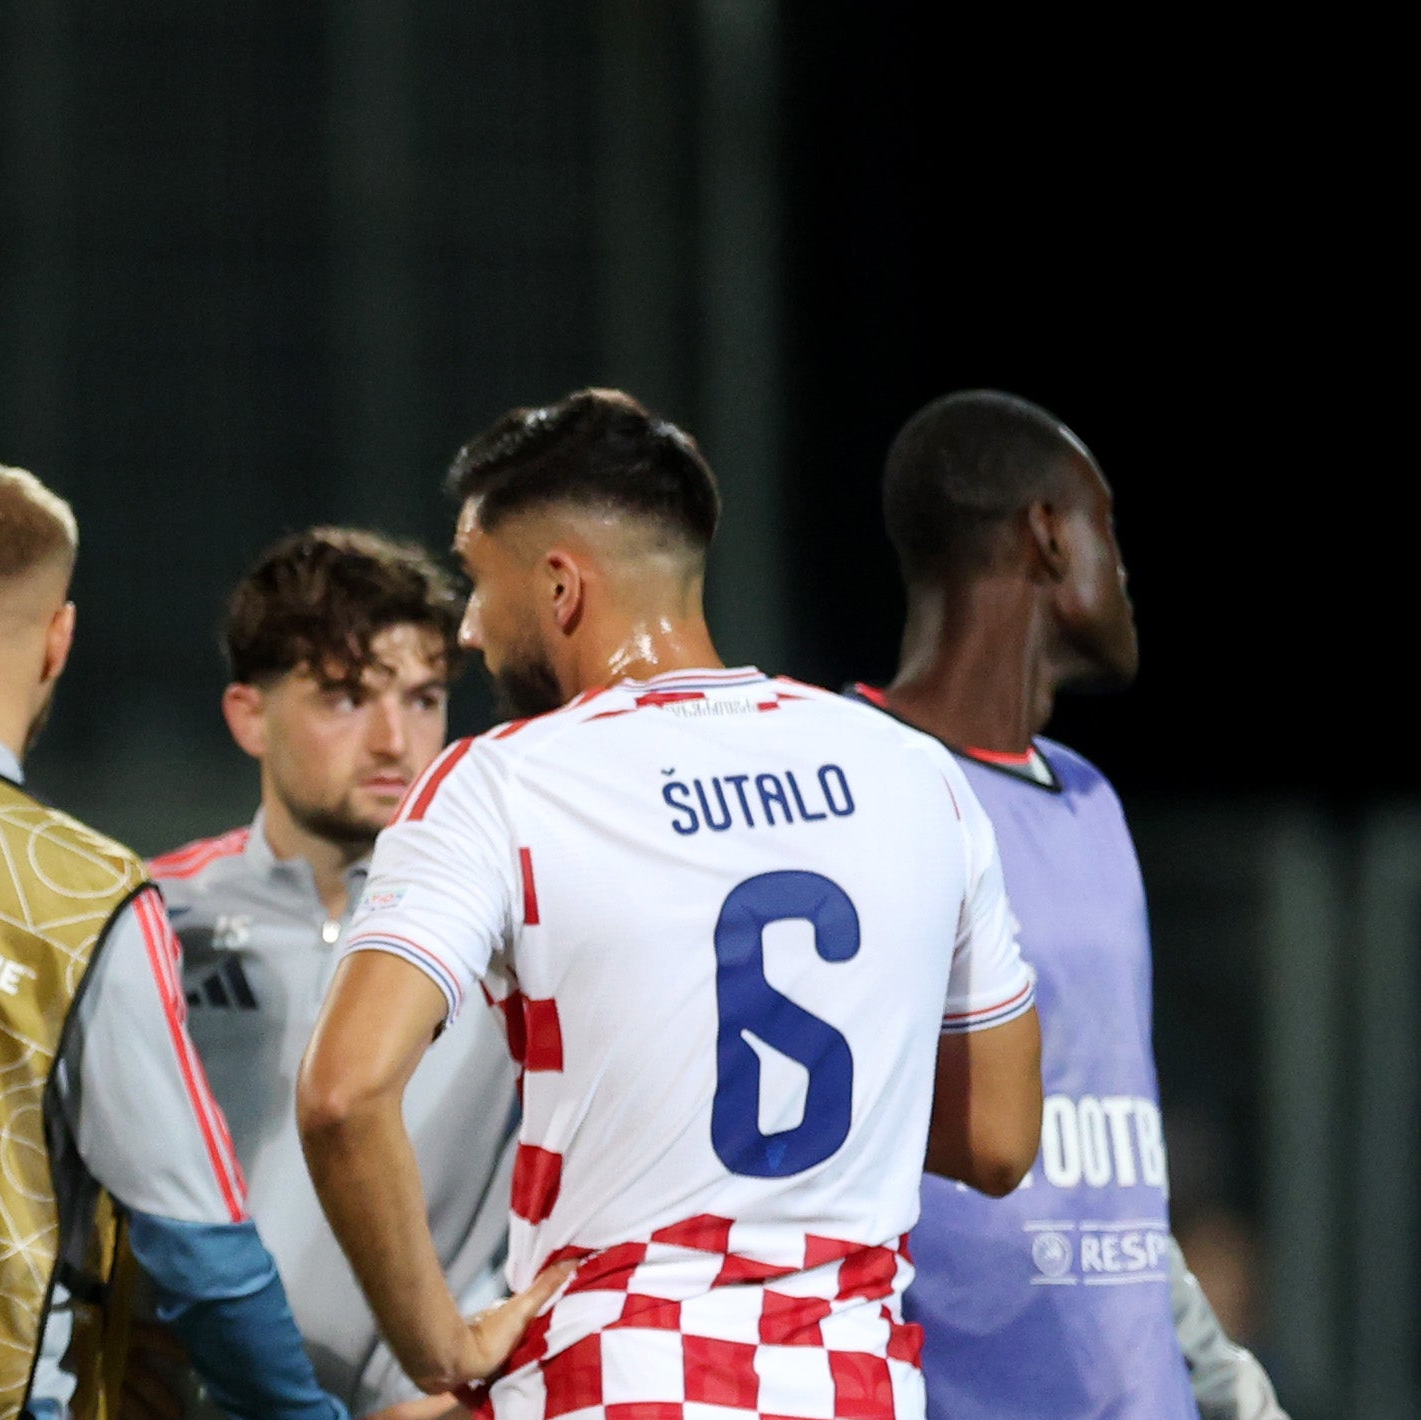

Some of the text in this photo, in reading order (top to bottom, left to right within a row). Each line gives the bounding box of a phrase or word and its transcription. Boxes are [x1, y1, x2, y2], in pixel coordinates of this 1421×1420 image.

[660, 764, 855, 836] ŠUTALO
[711, 869, 862, 1180] 6
[1080, 1230, 1172, 1273] RESP
